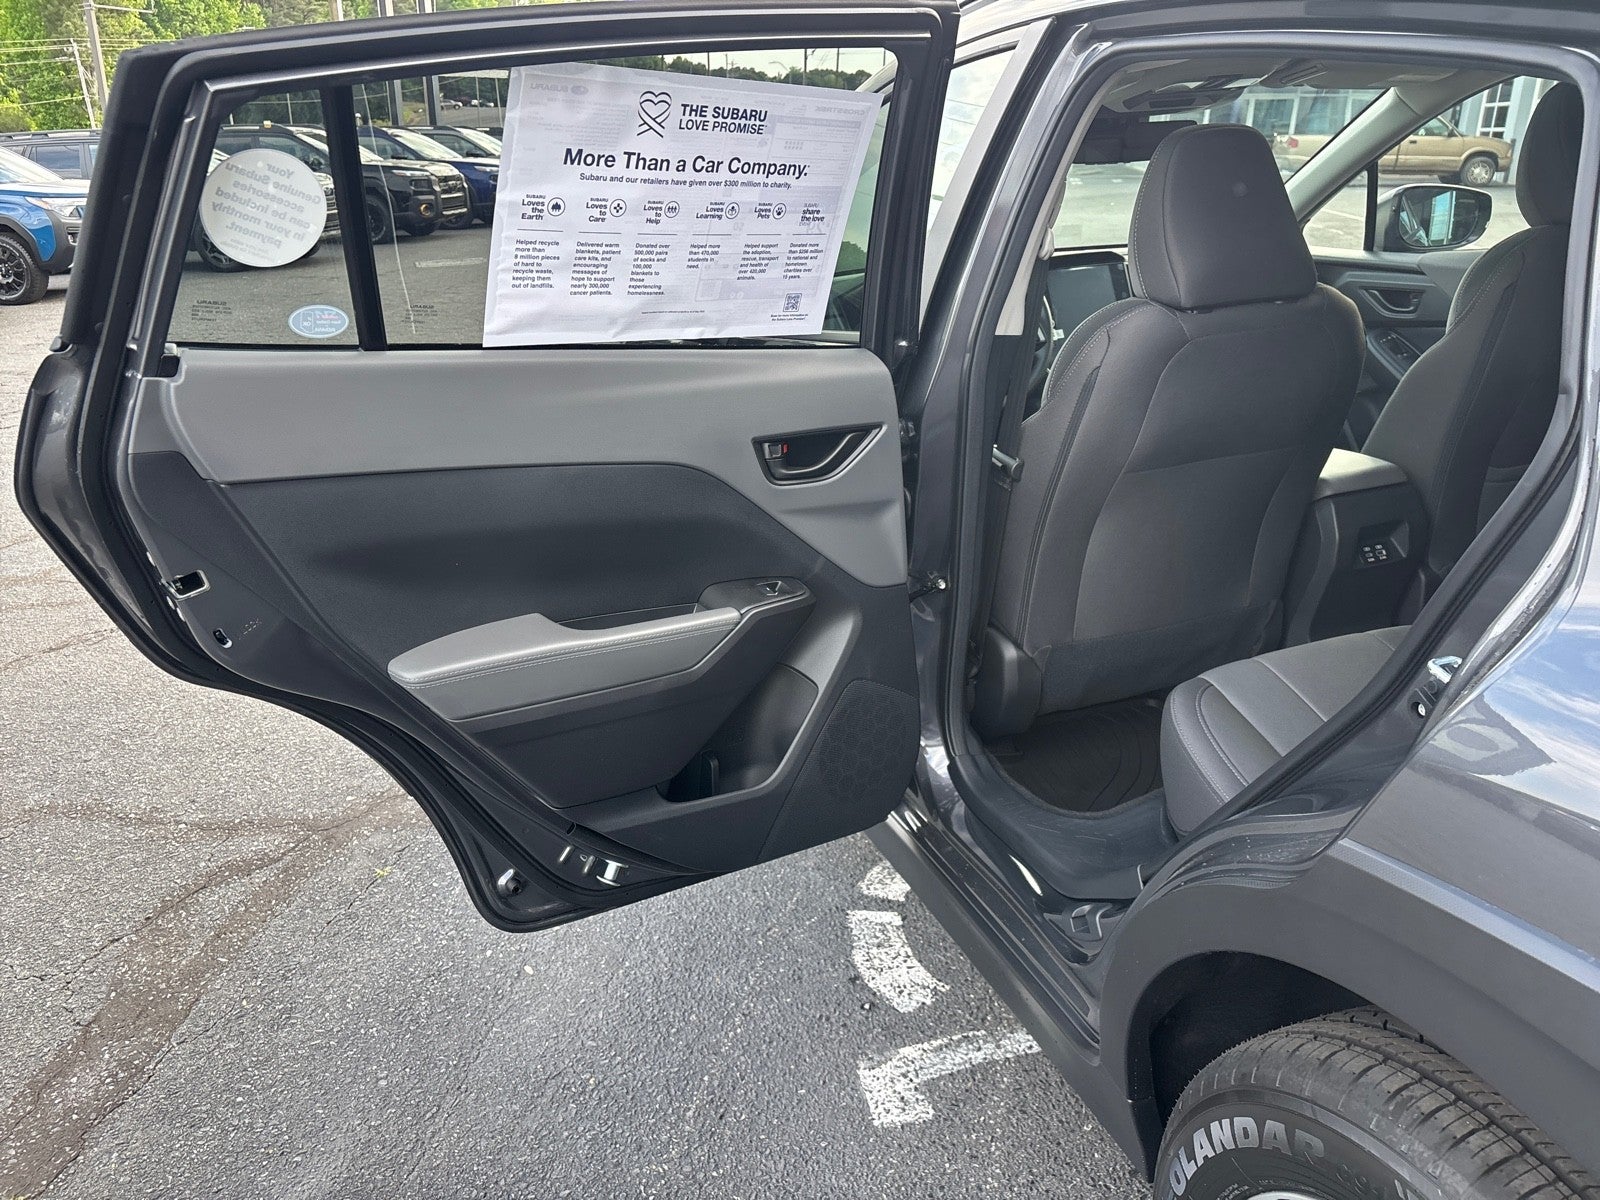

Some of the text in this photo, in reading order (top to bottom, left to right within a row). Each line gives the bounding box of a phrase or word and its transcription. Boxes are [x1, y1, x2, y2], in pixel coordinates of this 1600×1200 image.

[681, 104, 708, 118] THE
[712, 106, 768, 123] SUBARU
[679, 119, 710, 132] LOVE
[712, 121, 766, 135] PROMISE
[563, 148, 616, 168] More
[623, 151, 670, 172] Than
[676, 158, 686, 172] a
[692, 156, 723, 174] Car
[580, 173, 607, 182] Subaru
[609, 175, 624, 183] and
[640, 176, 669, 185] retailers
[671, 178, 687, 186] have
[689, 179, 706, 188] given
[724, 180, 739, 188] $300
[740, 180, 761, 188] million
[770, 181, 791, 189] charity.
[1167, 1116, 1325, 1200] OLANDAR
